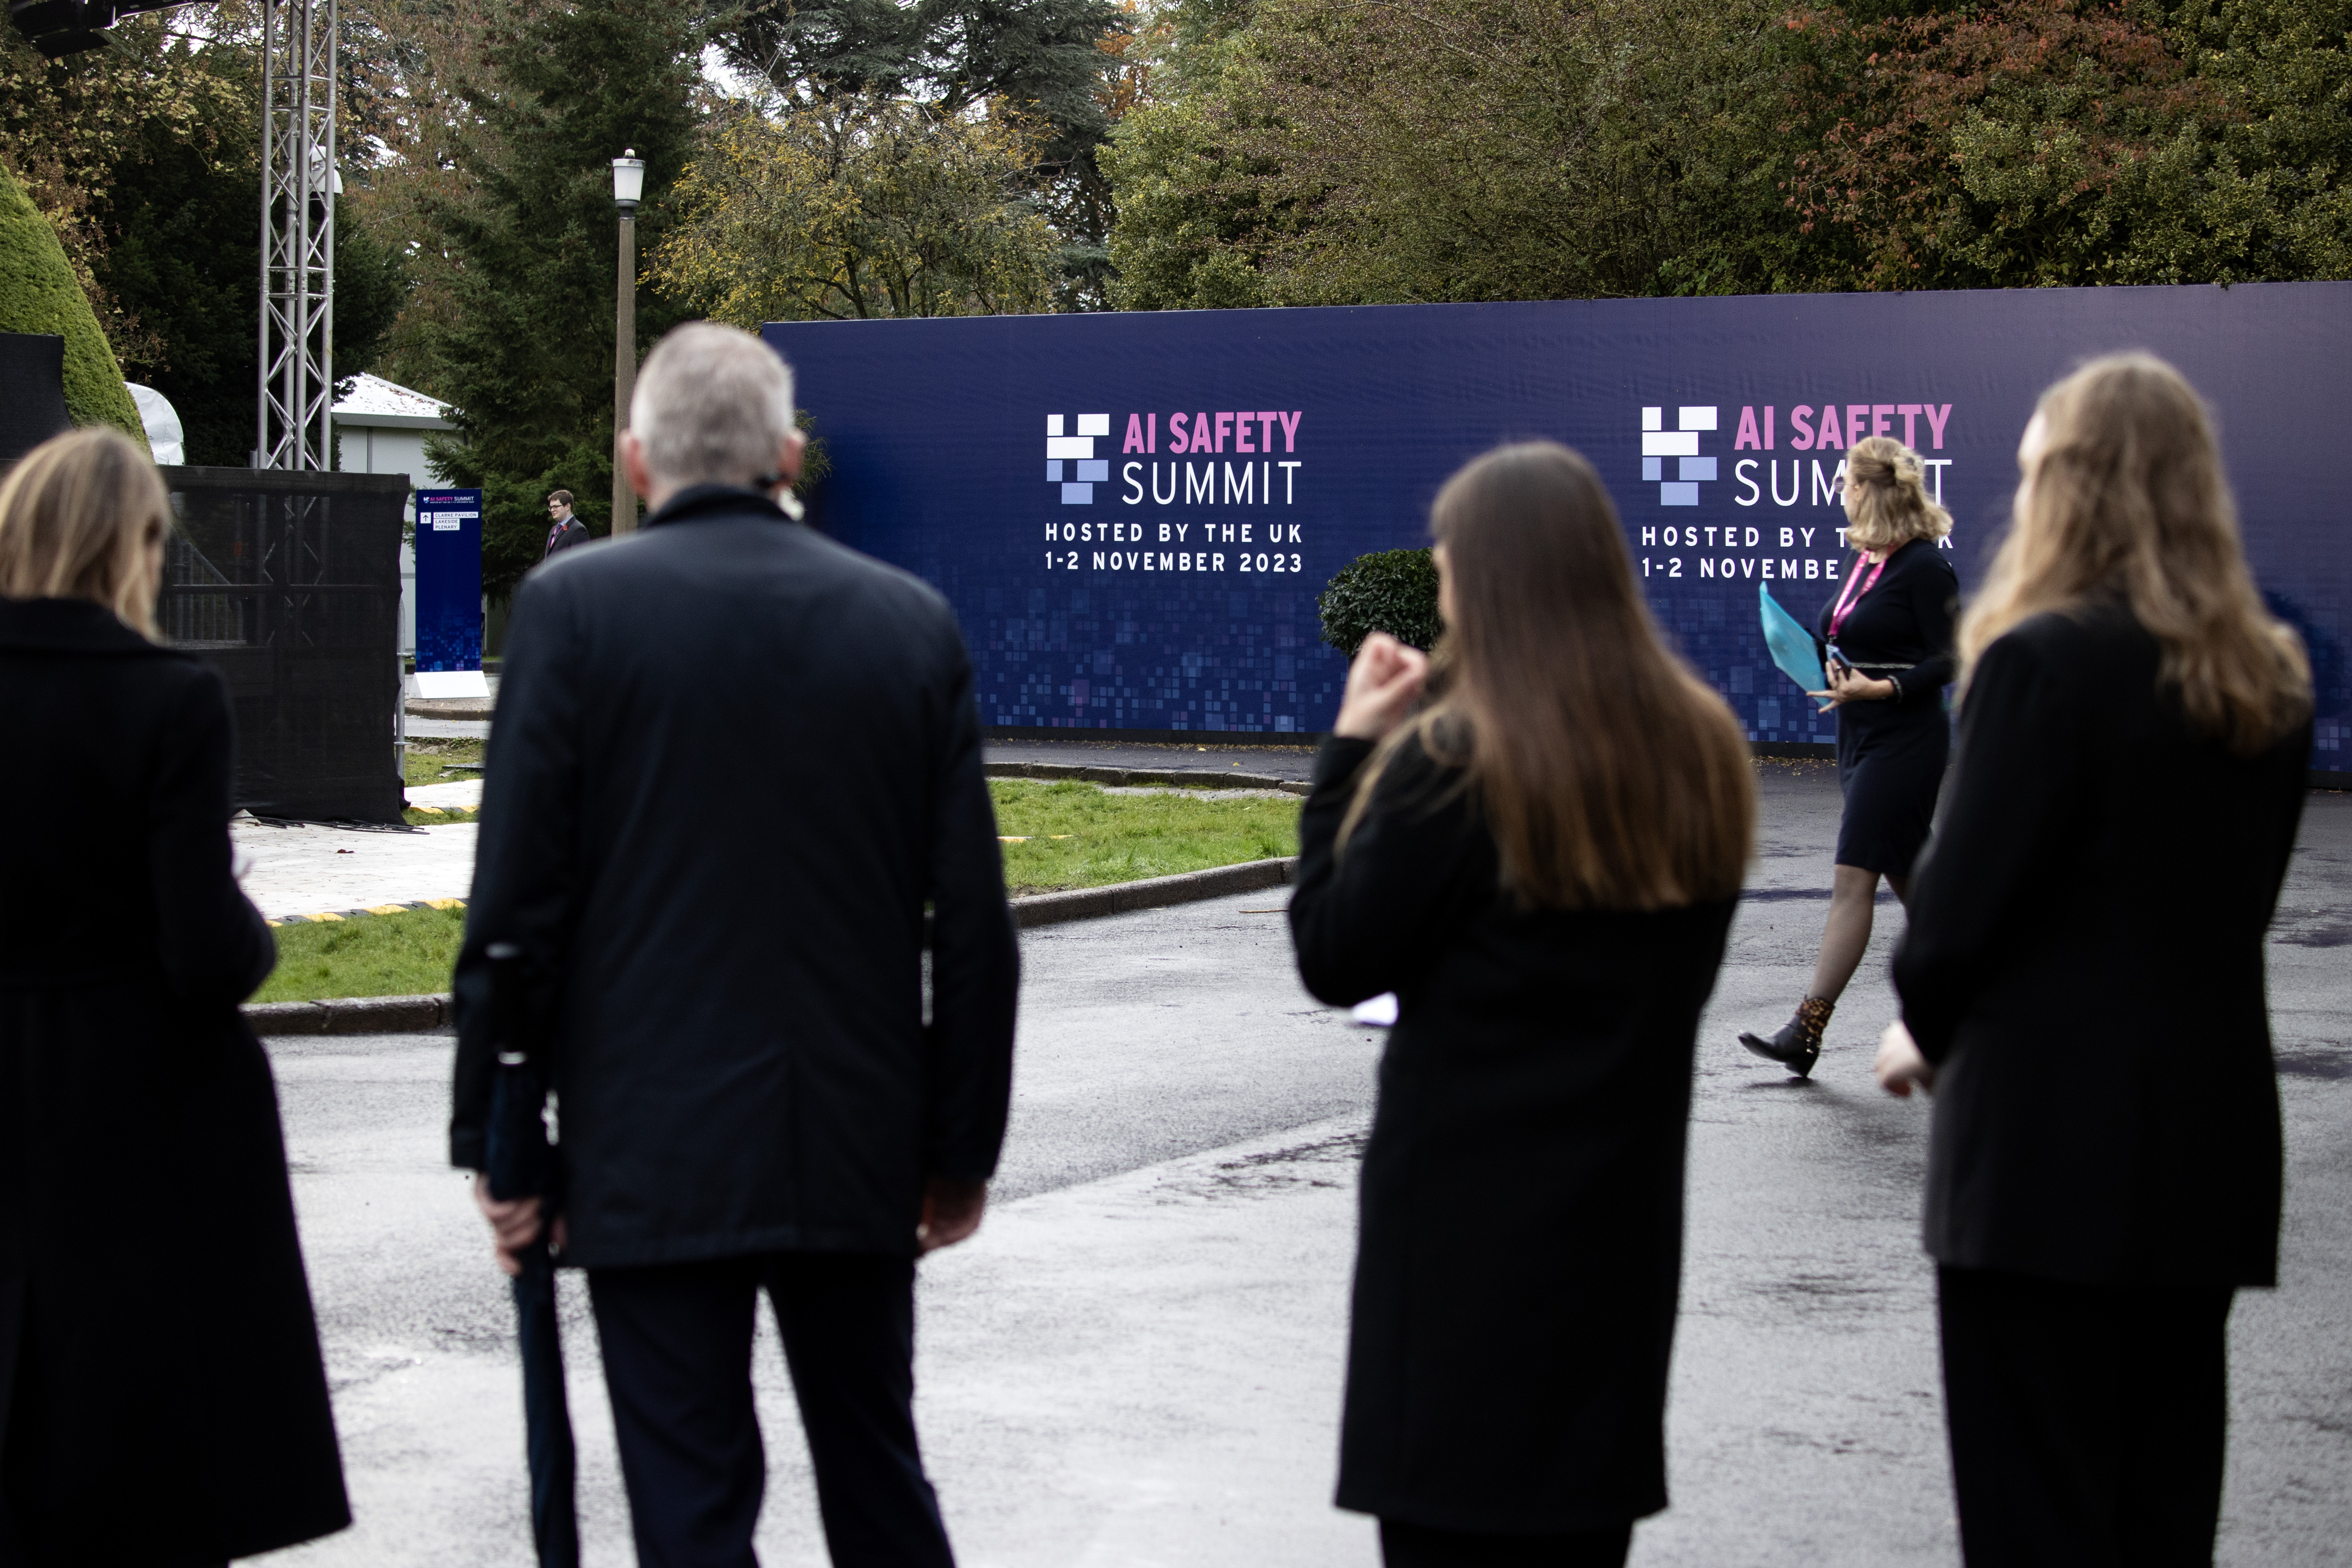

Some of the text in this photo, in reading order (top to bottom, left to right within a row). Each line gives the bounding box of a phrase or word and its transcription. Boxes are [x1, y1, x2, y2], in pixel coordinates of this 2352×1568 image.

[1122, 411, 1303, 454] AI SAFETY
[1734, 403, 1953, 450] AI SAFETY
[1122, 461, 1302, 505] SUMMIT
[1734, 459, 1952, 507] SUMT
[1045, 523, 1302, 543] HOSTED BY THE UK
[1642, 526, 1759, 547] HOSTED
[1780, 527, 1816, 548] BY
[1045, 551, 1302, 572] 1-2 NOVEMBER 2023
[1642, 557, 1839, 579] 1-2 NOVEMBE
